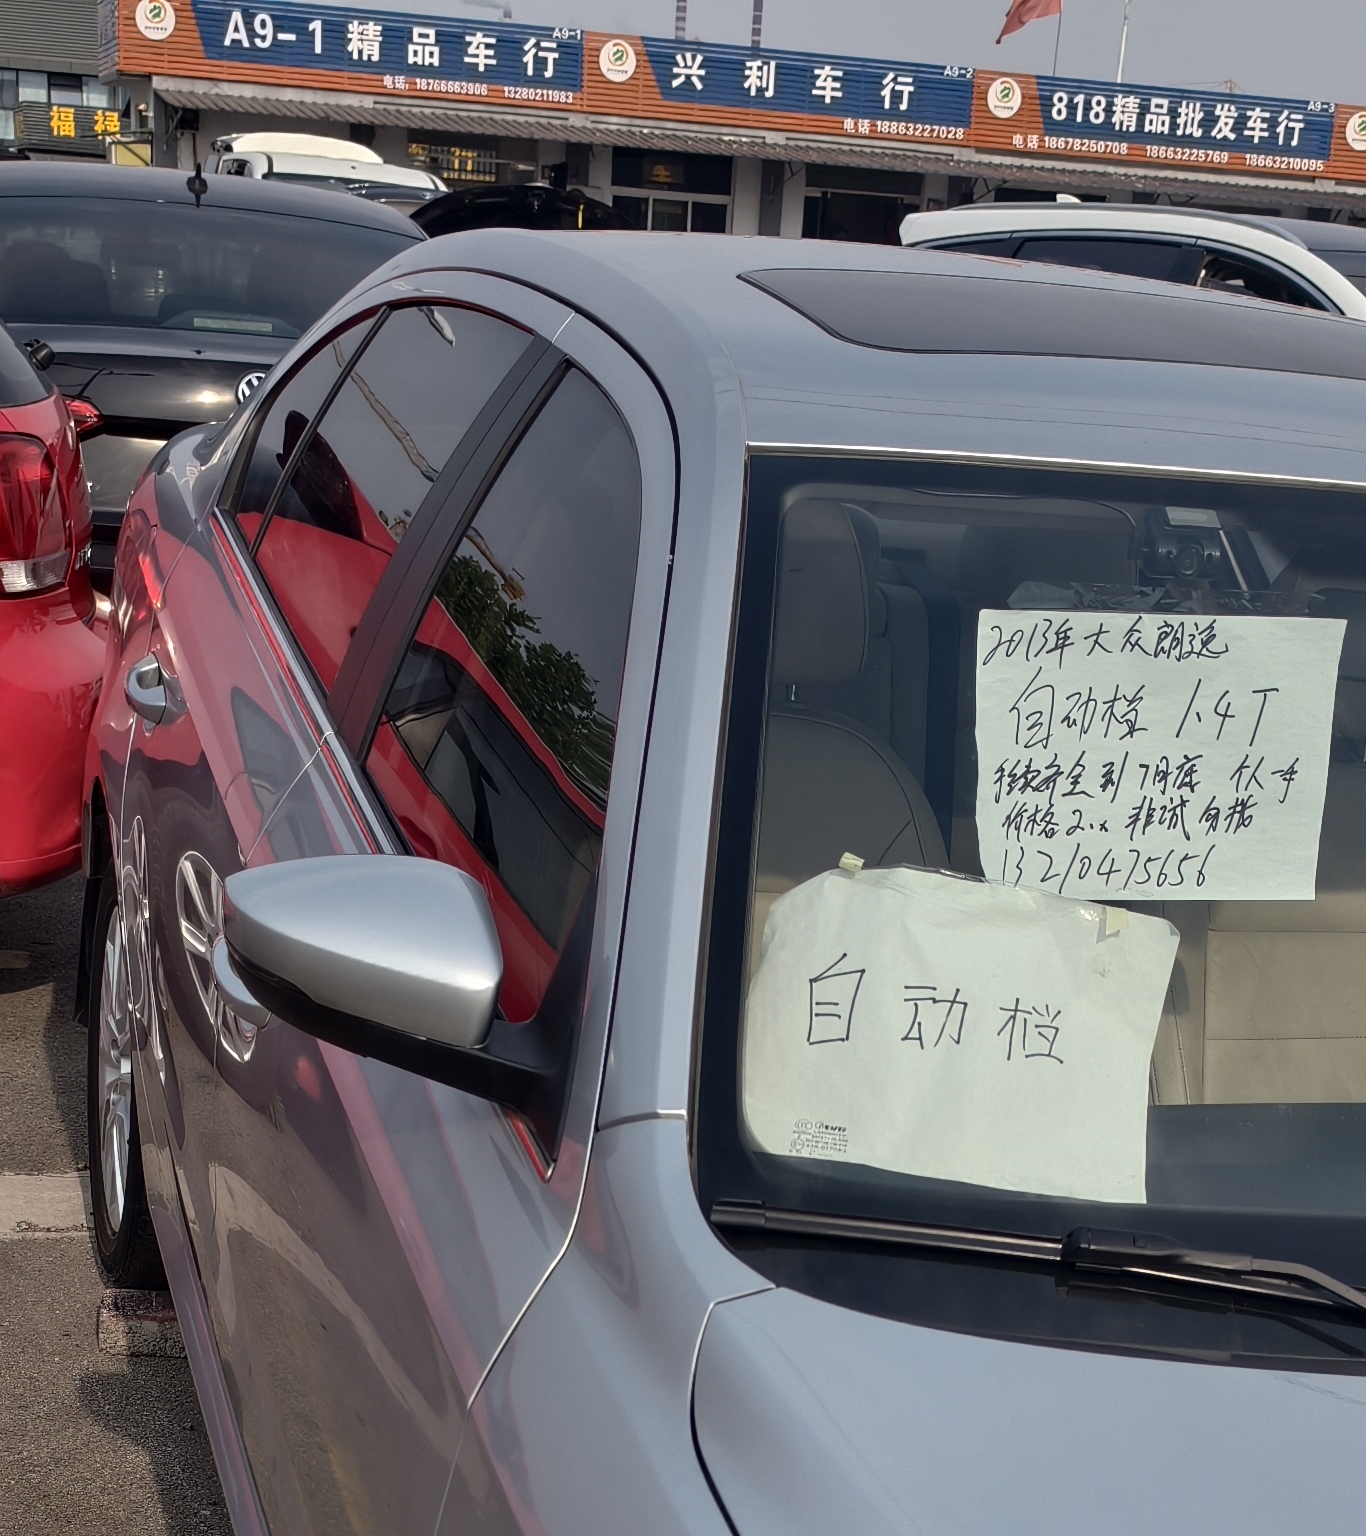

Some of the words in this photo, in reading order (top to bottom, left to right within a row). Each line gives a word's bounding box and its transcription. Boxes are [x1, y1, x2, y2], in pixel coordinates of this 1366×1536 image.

[552, 26, 582, 41] A9-1
[672, 52, 914, 111] 兴利车行
[944, 65, 975, 79] A9-2
[50, 105, 76, 138] 福
[1051, 91, 1305, 147] 818精品批发车行
[1307, 101, 1336, 113] A9-3
[843, 118, 871, 135] 电话
[876, 120, 965, 140] 18863227028
[1012, 134, 1039, 149] 电话
[1044, 136, 1128, 155] 18678250708
[1145, 144, 1229, 164] 18663225769
[1245, 153, 1325, 172] 18663210095
[807, 953, 1064, 1063] 自动档
